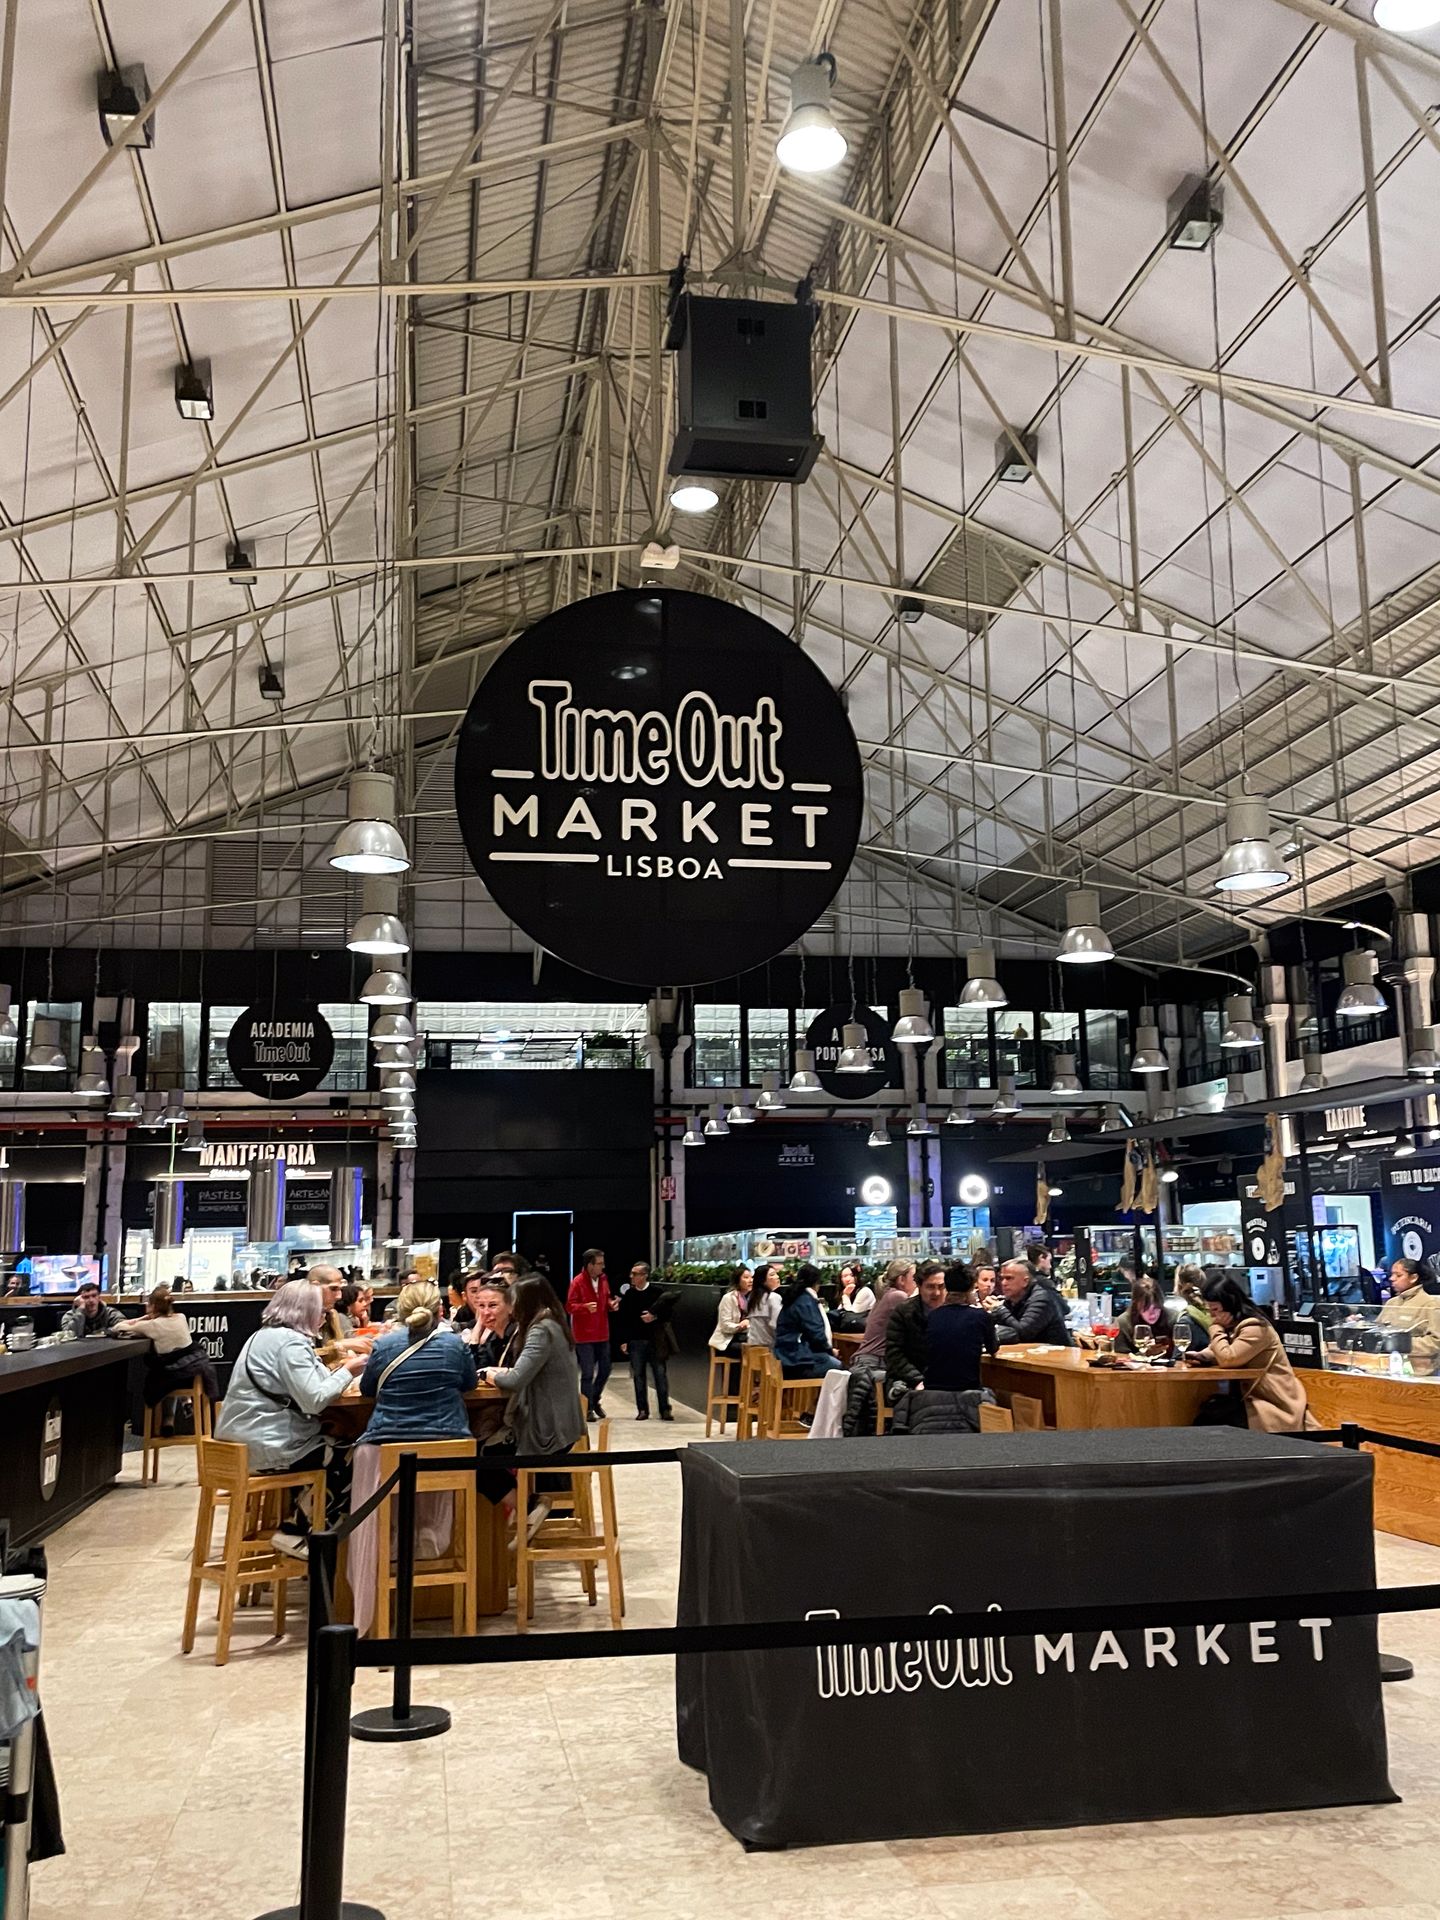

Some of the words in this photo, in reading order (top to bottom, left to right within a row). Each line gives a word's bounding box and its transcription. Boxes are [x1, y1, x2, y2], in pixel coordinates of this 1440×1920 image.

[528, 680, 671, 785] Time
[675, 691, 784, 790] Out
[493, 793, 829, 848] MARKET
[606, 854, 724, 879] LISBOA
[250, 1022, 315, 1038] ACADEMIA
[253, 1041, 286, 1063] Time
[286, 1041, 311, 1063] Out
[262, 1073, 300, 1082] TEKA
[1034, 1617, 1332, 1675] MARKET
